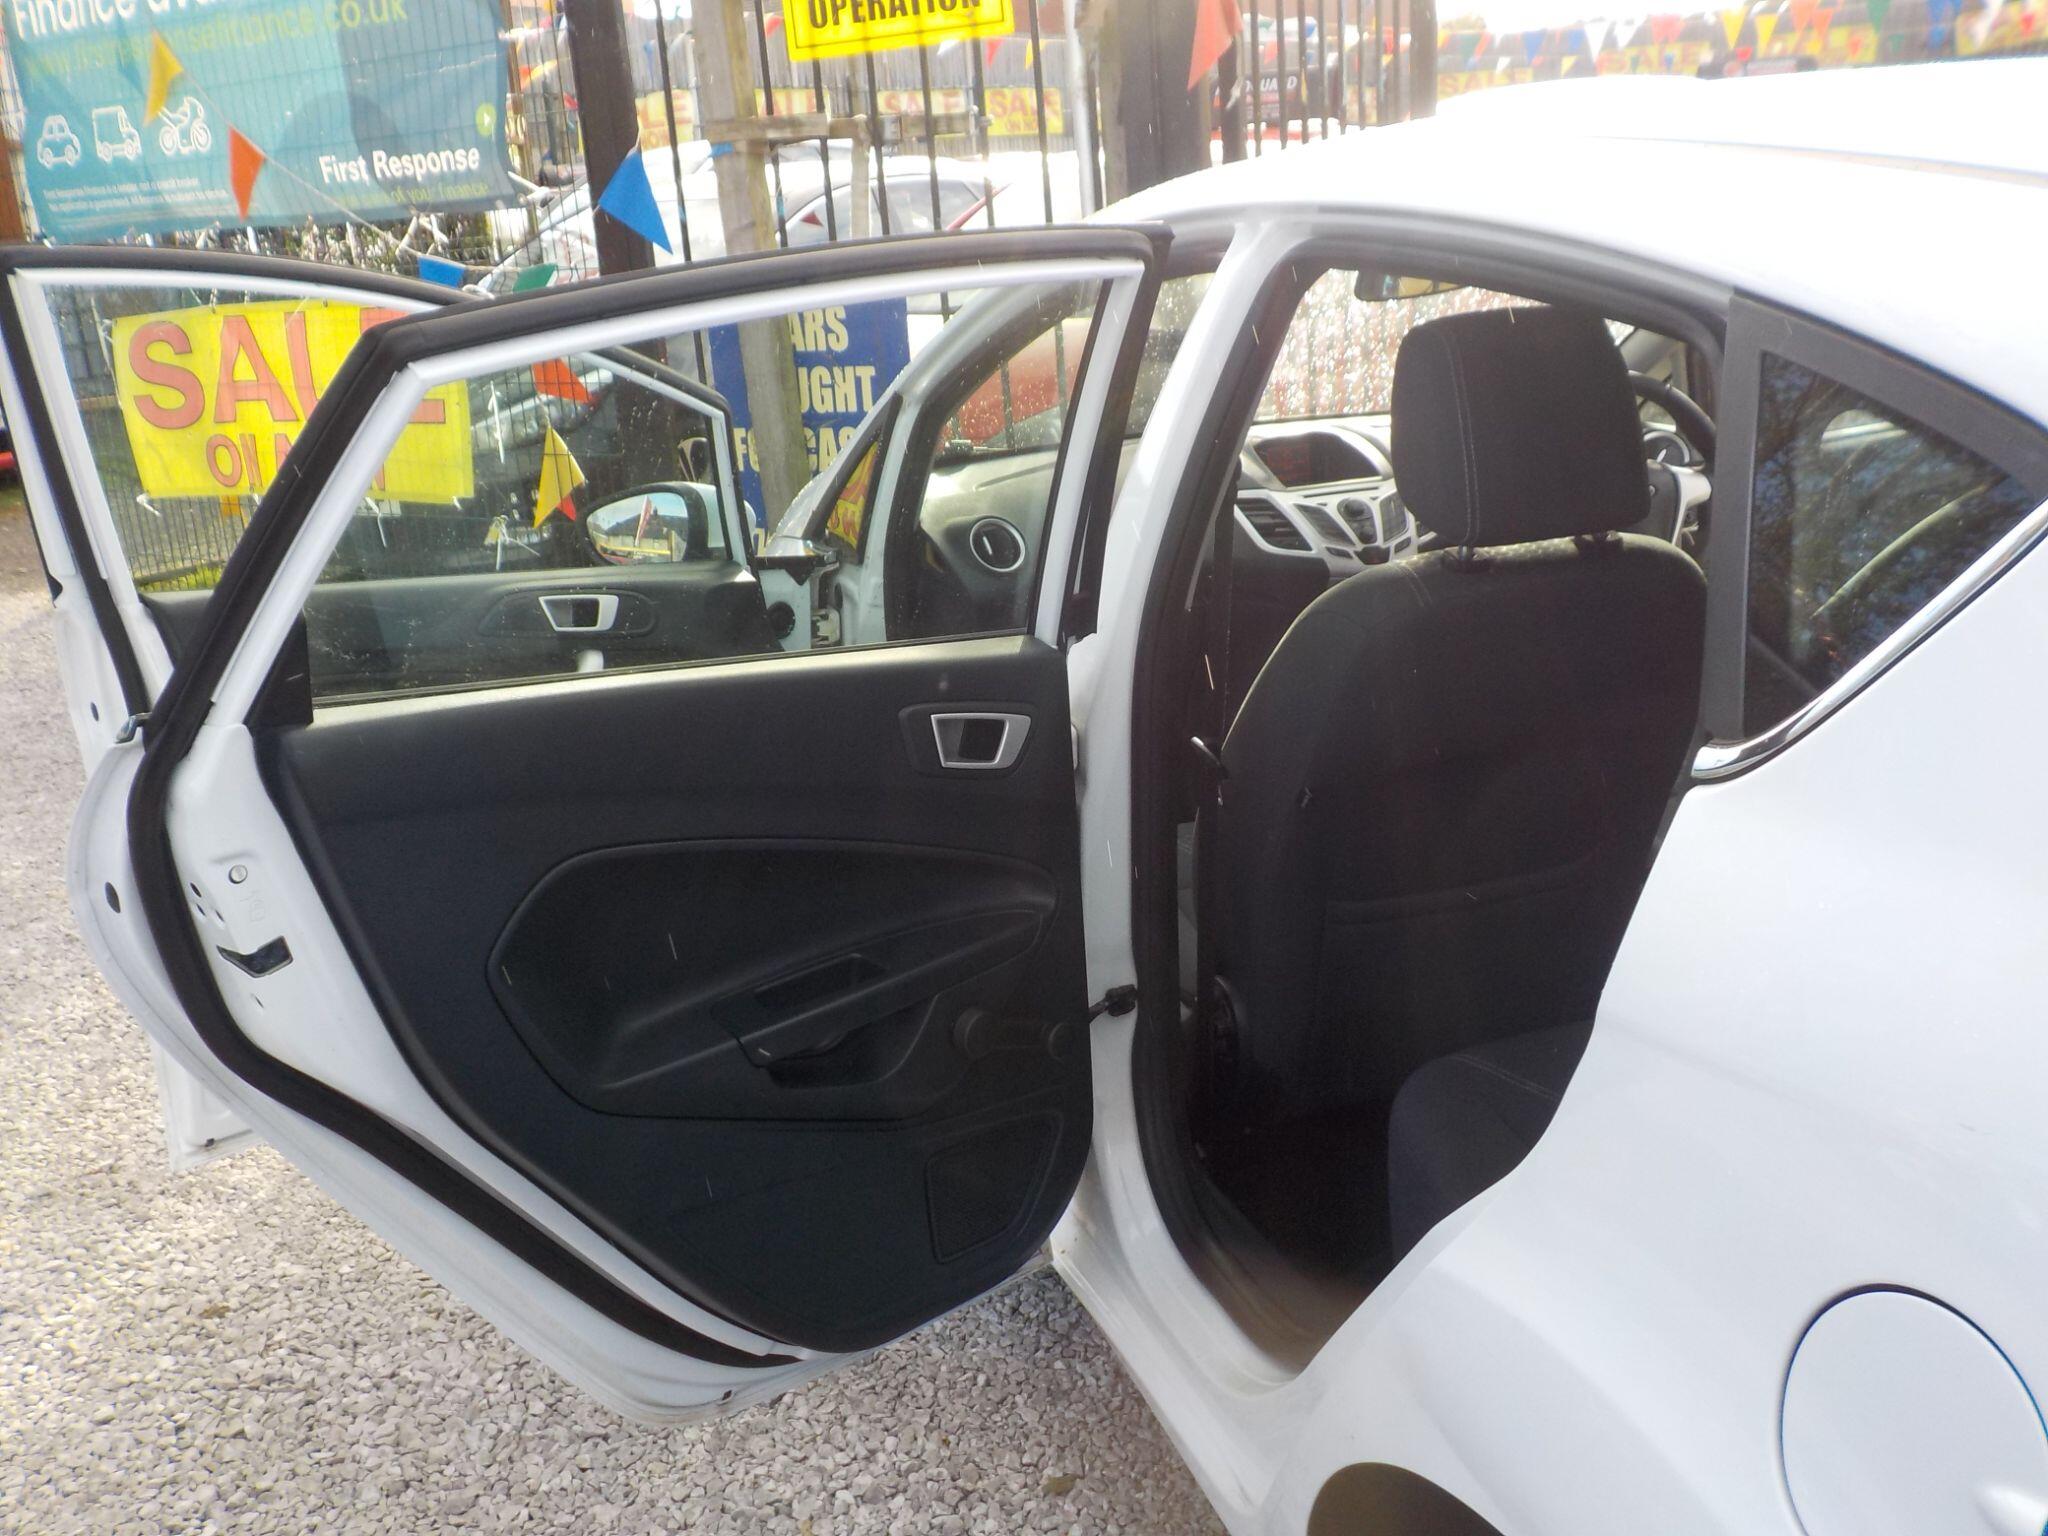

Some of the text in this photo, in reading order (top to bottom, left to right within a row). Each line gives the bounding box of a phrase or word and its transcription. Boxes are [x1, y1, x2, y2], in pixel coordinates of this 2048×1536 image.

[10, 0, 137, 41] Finance
[809, 0, 981, 29] OPERA
[319, 147, 480, 187] First Response
[787, 305, 849, 352] ARS
[798, 365, 876, 414] UGHT
[205, 432, 263, 488] ON
